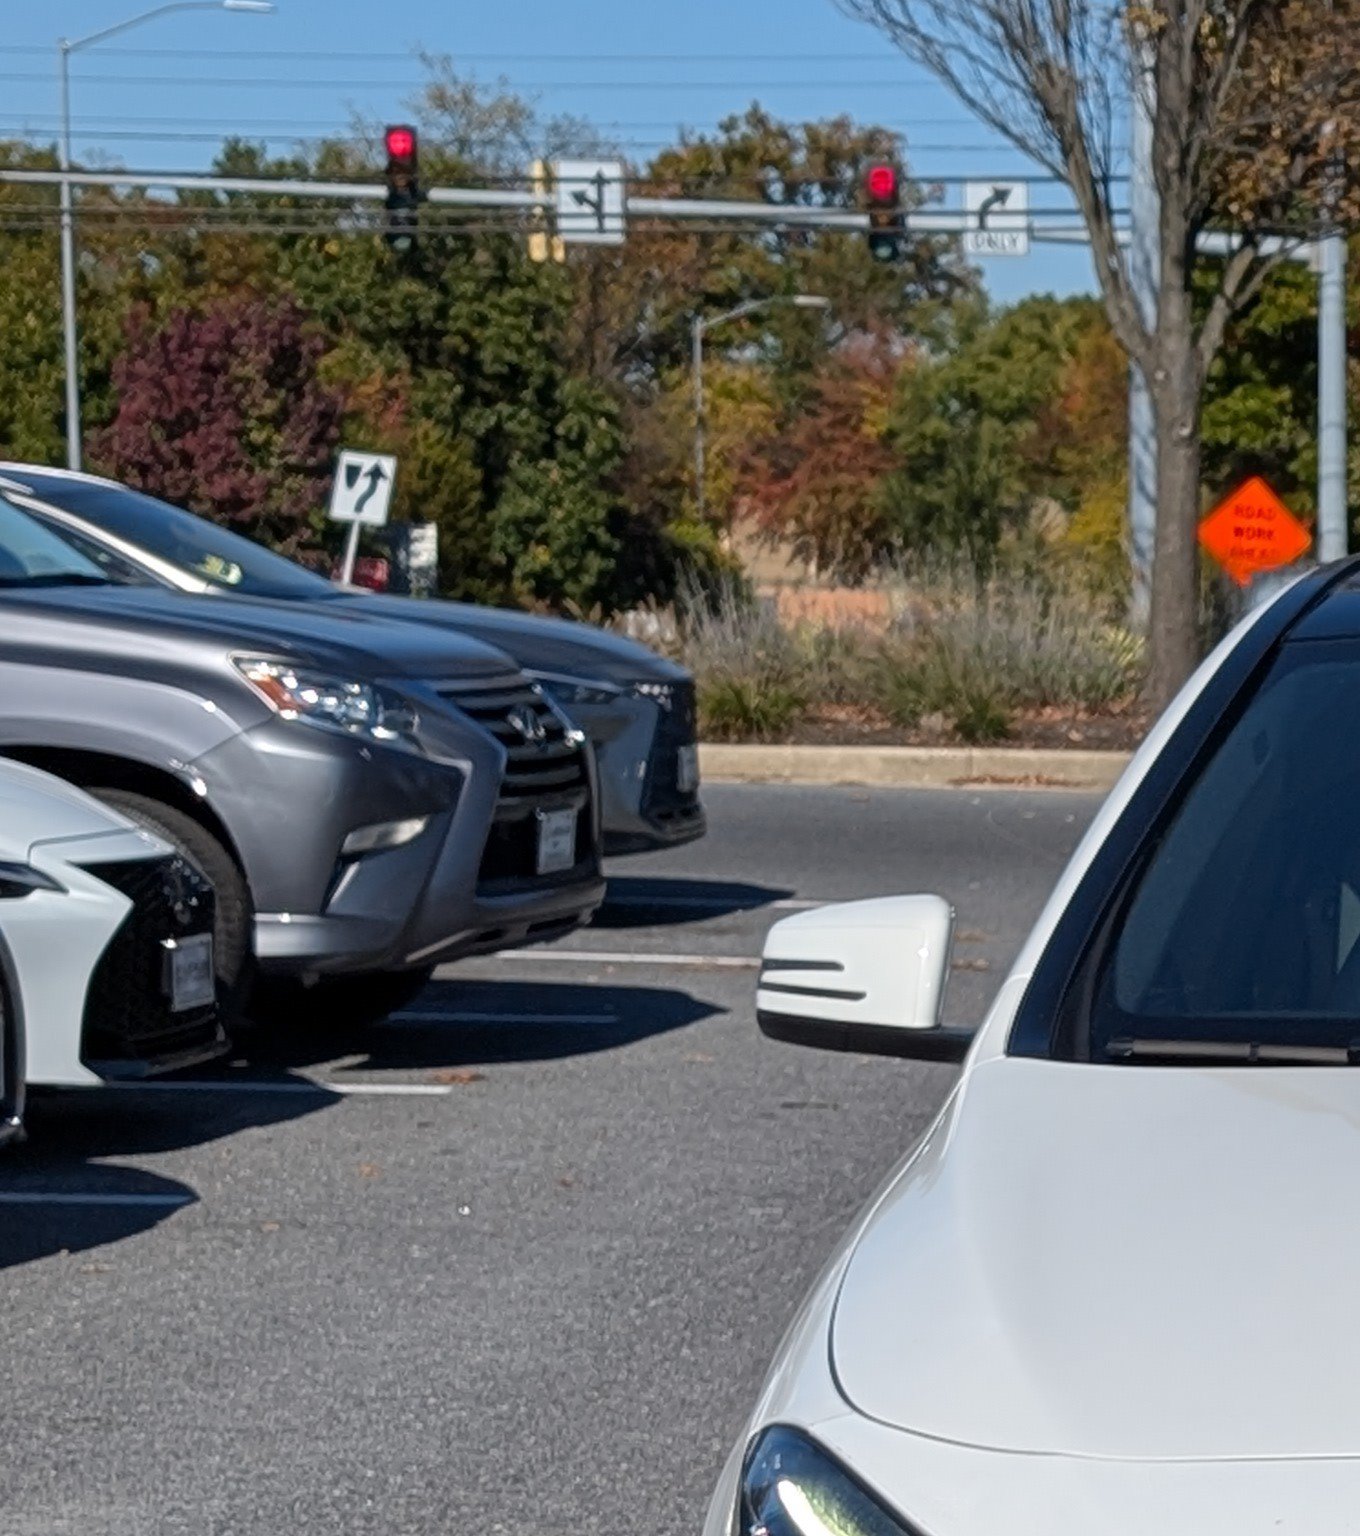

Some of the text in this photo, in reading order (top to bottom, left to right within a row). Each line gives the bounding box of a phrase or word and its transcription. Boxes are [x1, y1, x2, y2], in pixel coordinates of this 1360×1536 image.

[973, 231, 1019, 250] ONLY
[1234, 505, 1276, 520] ROAD
[1233, 526, 1275, 540] WORK
